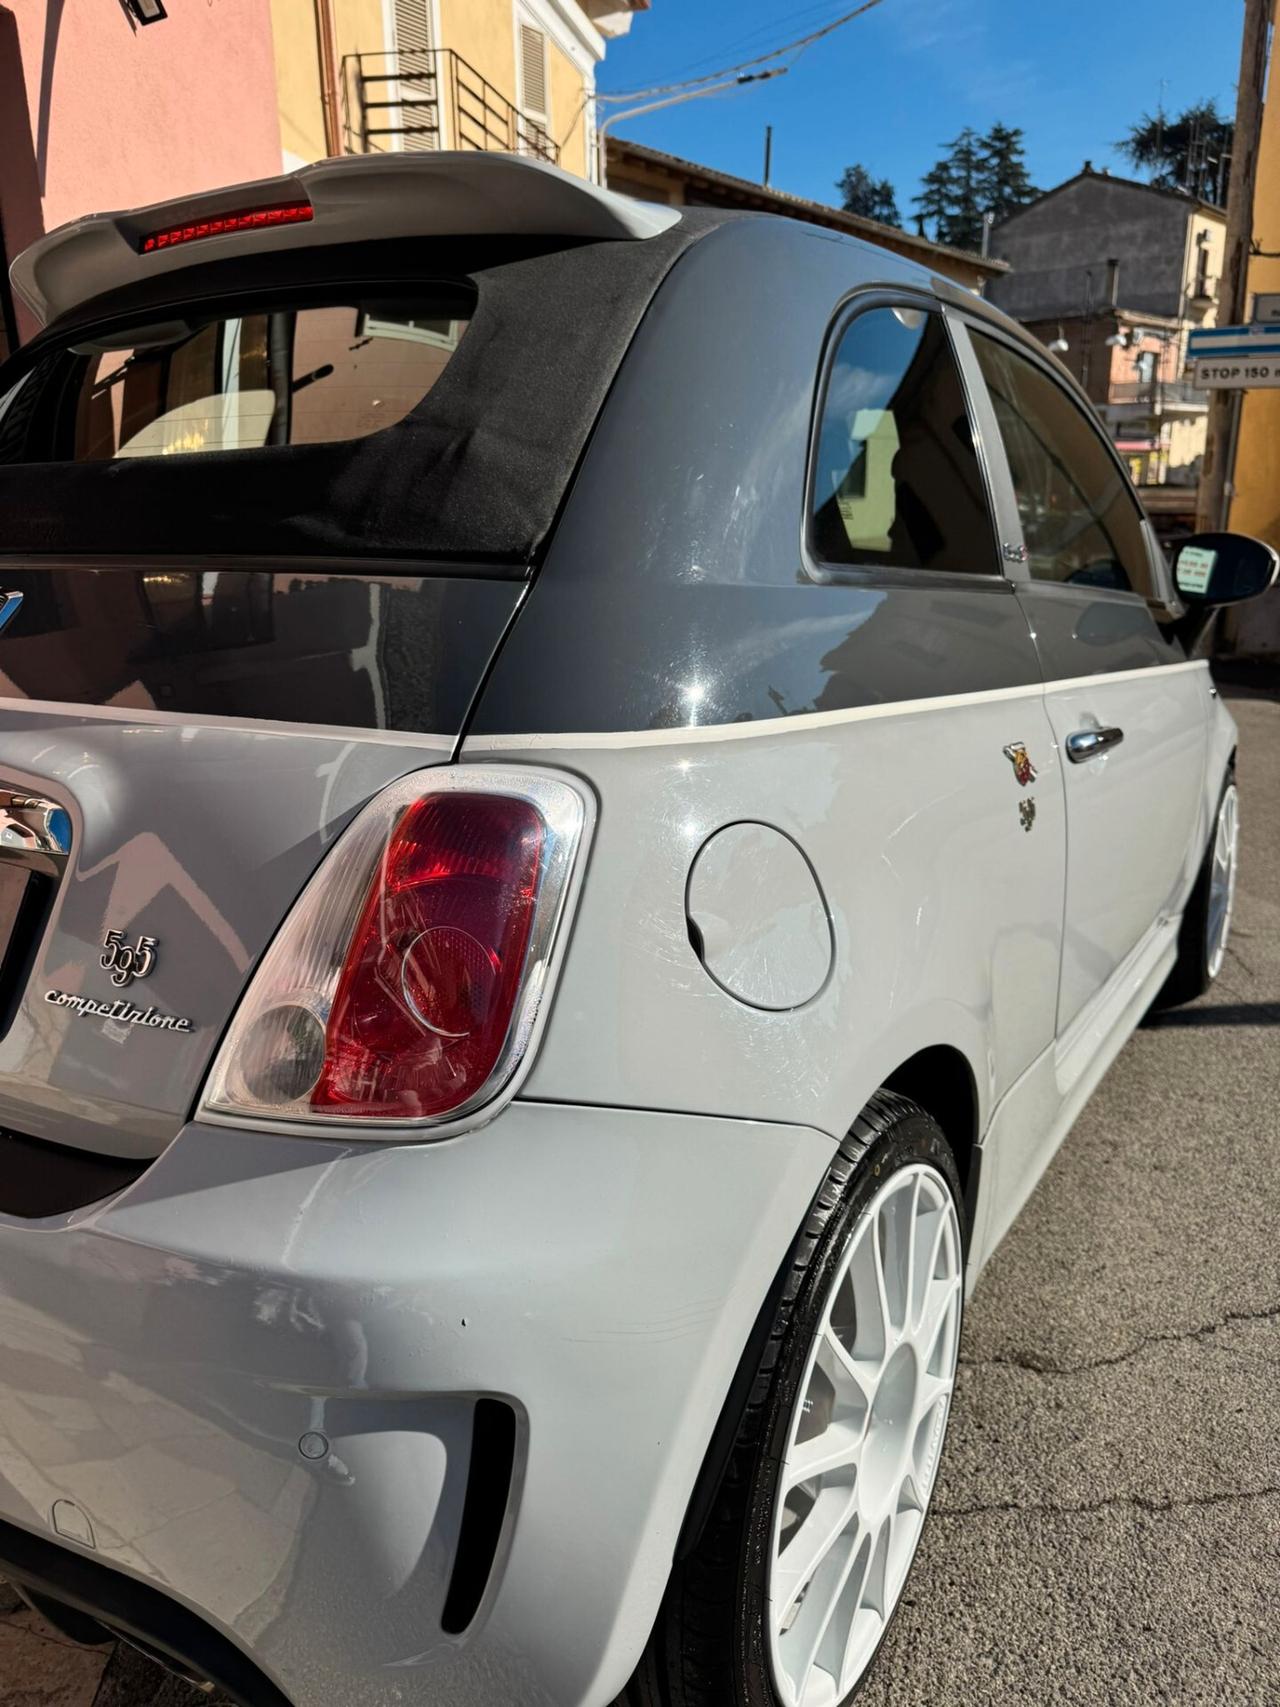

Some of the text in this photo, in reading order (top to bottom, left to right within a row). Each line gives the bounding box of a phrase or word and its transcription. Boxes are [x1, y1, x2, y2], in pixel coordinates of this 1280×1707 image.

[1201, 367, 1240, 379] STOP
[1245, 366, 1269, 378] 150
[100, 929, 158, 987] 595
[44, 990, 194, 1032] competizione
